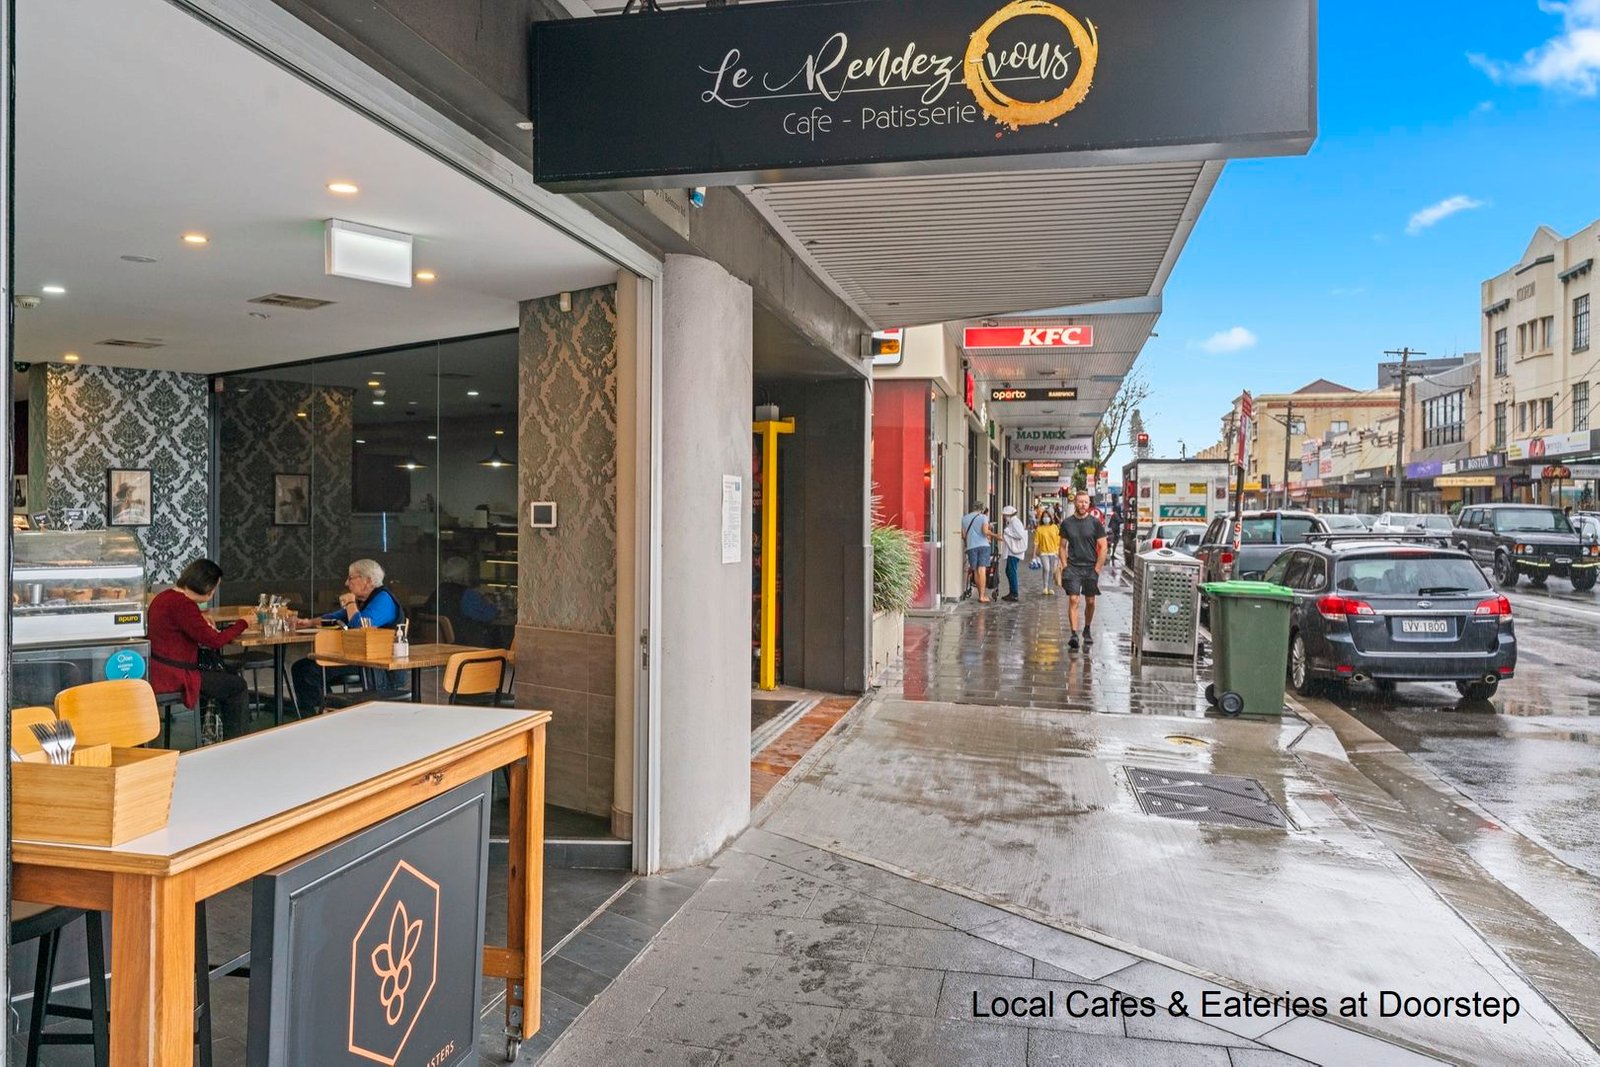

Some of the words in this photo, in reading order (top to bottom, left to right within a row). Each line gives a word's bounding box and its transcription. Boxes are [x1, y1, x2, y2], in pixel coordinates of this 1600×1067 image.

[698, 48, 753, 108] Le
[783, 106, 832, 141] Cafe
[862, 101, 977, 130] Patisserie
[1020, 327, 1082, 346] KFC
[992, 390, 1027, 400] oparto
[1016, 431, 1040, 440] MAD
[1042, 431, 1066, 440] MEX
[1024, 443, 1046, 452] Royal
[1049, 443, 1089, 451] Randwick
[1468, 456, 1489, 469] BOSTON
[1163, 507, 1202, 517] TOLL
[427, 1040, 455, 1067] STERS
